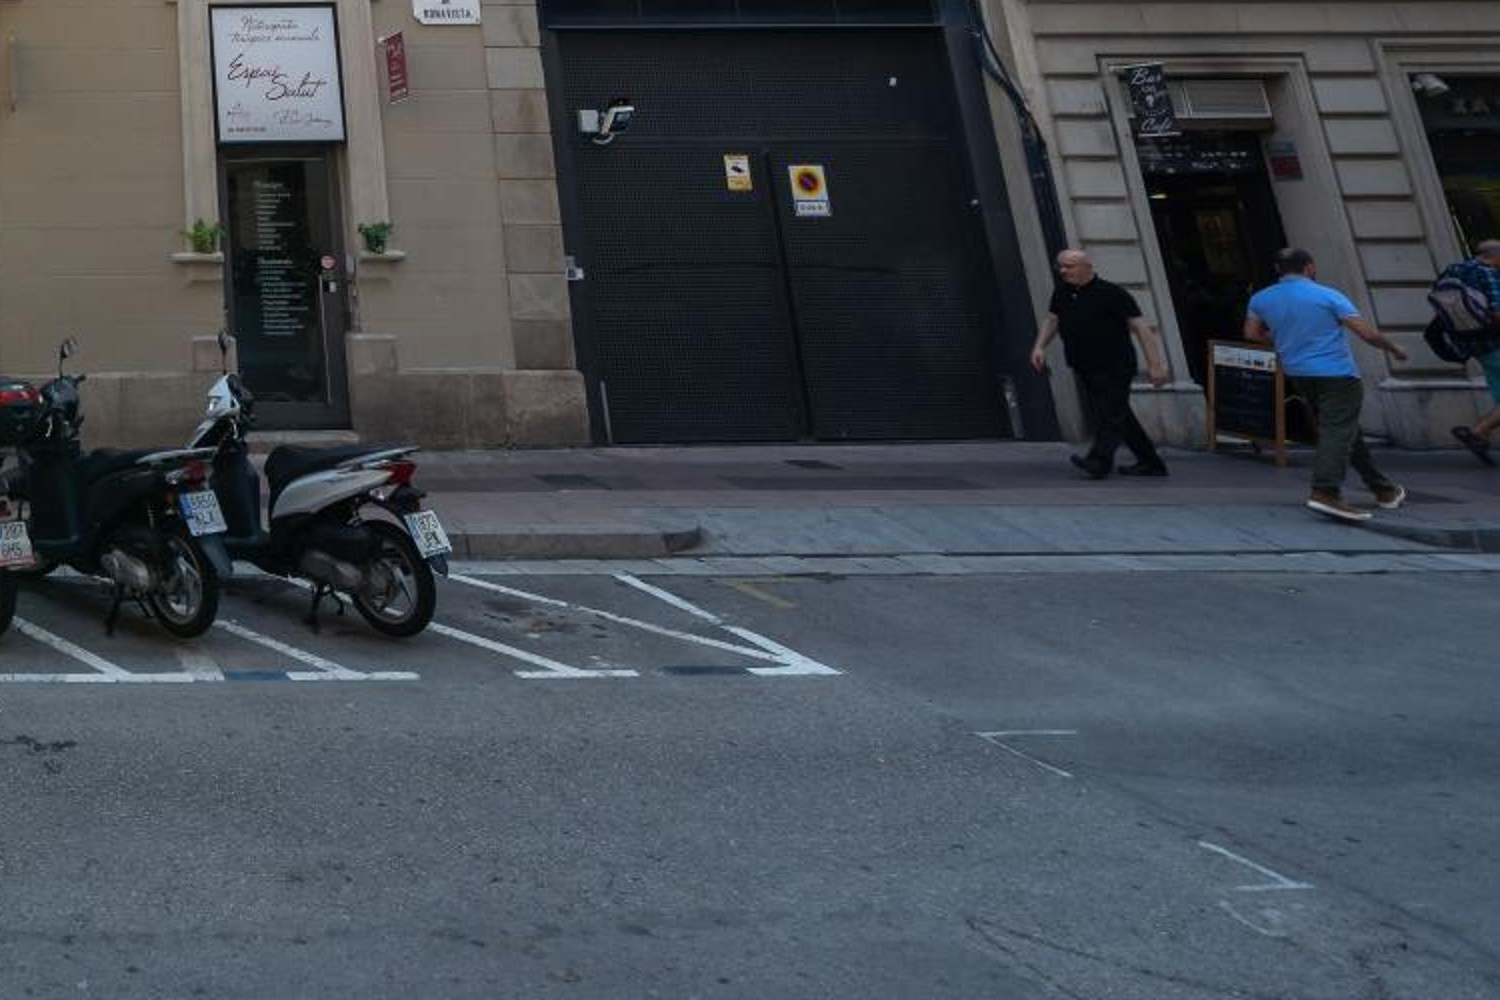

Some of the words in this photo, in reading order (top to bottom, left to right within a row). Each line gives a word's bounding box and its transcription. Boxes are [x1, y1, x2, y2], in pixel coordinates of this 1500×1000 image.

[423, 8, 472, 19] BONAVISTA
[228, 53, 277, 88] Espai
[1131, 67, 1162, 85] Bar
[266, 72, 328, 101] Salut
